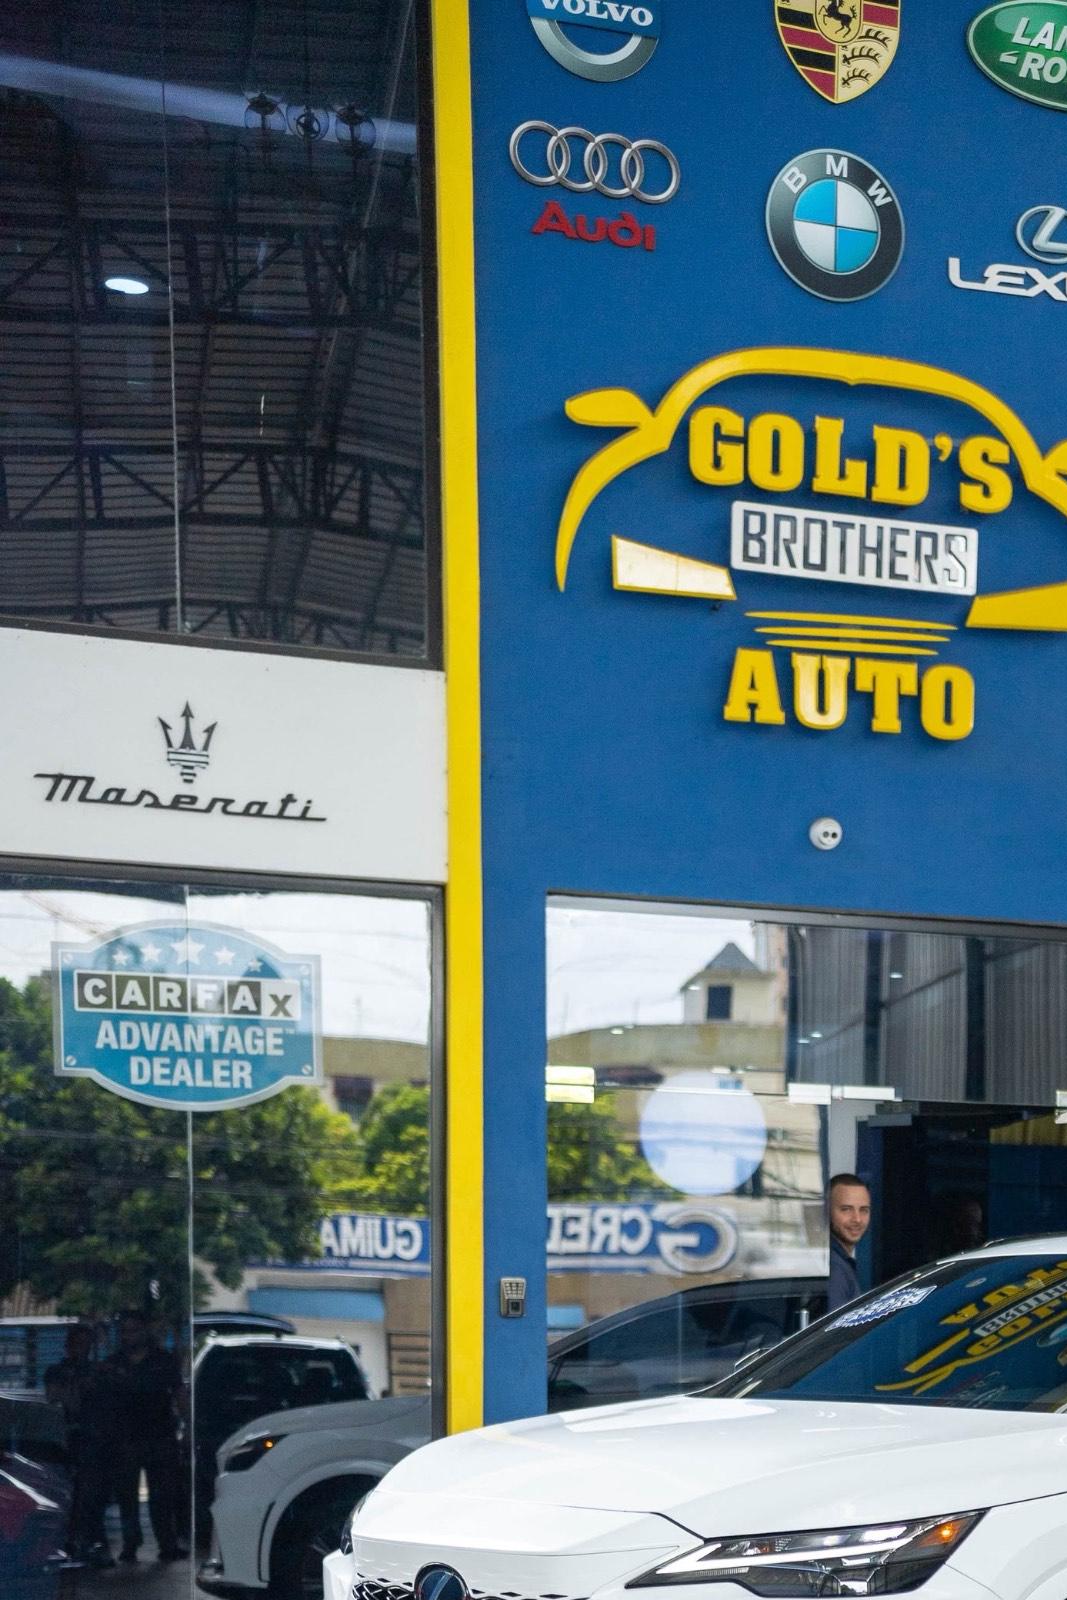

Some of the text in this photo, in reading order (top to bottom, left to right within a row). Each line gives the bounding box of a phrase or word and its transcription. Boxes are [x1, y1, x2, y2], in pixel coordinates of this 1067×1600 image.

[538, 0, 654, 27] VOLVO
[783, 155, 892, 208] BMW
[532, 201, 655, 251] Audi
[689, 405, 1012, 513] GOLD'S
[741, 511, 969, 585] BROTHERS
[724, 648, 975, 741] AUTO
[33, 772, 327, 822] Maserati
[83, 976, 293, 1016] CARFAX
[96, 1019, 285, 1056] ADVANTAGE
[130, 1057, 253, 1089] DEALER
